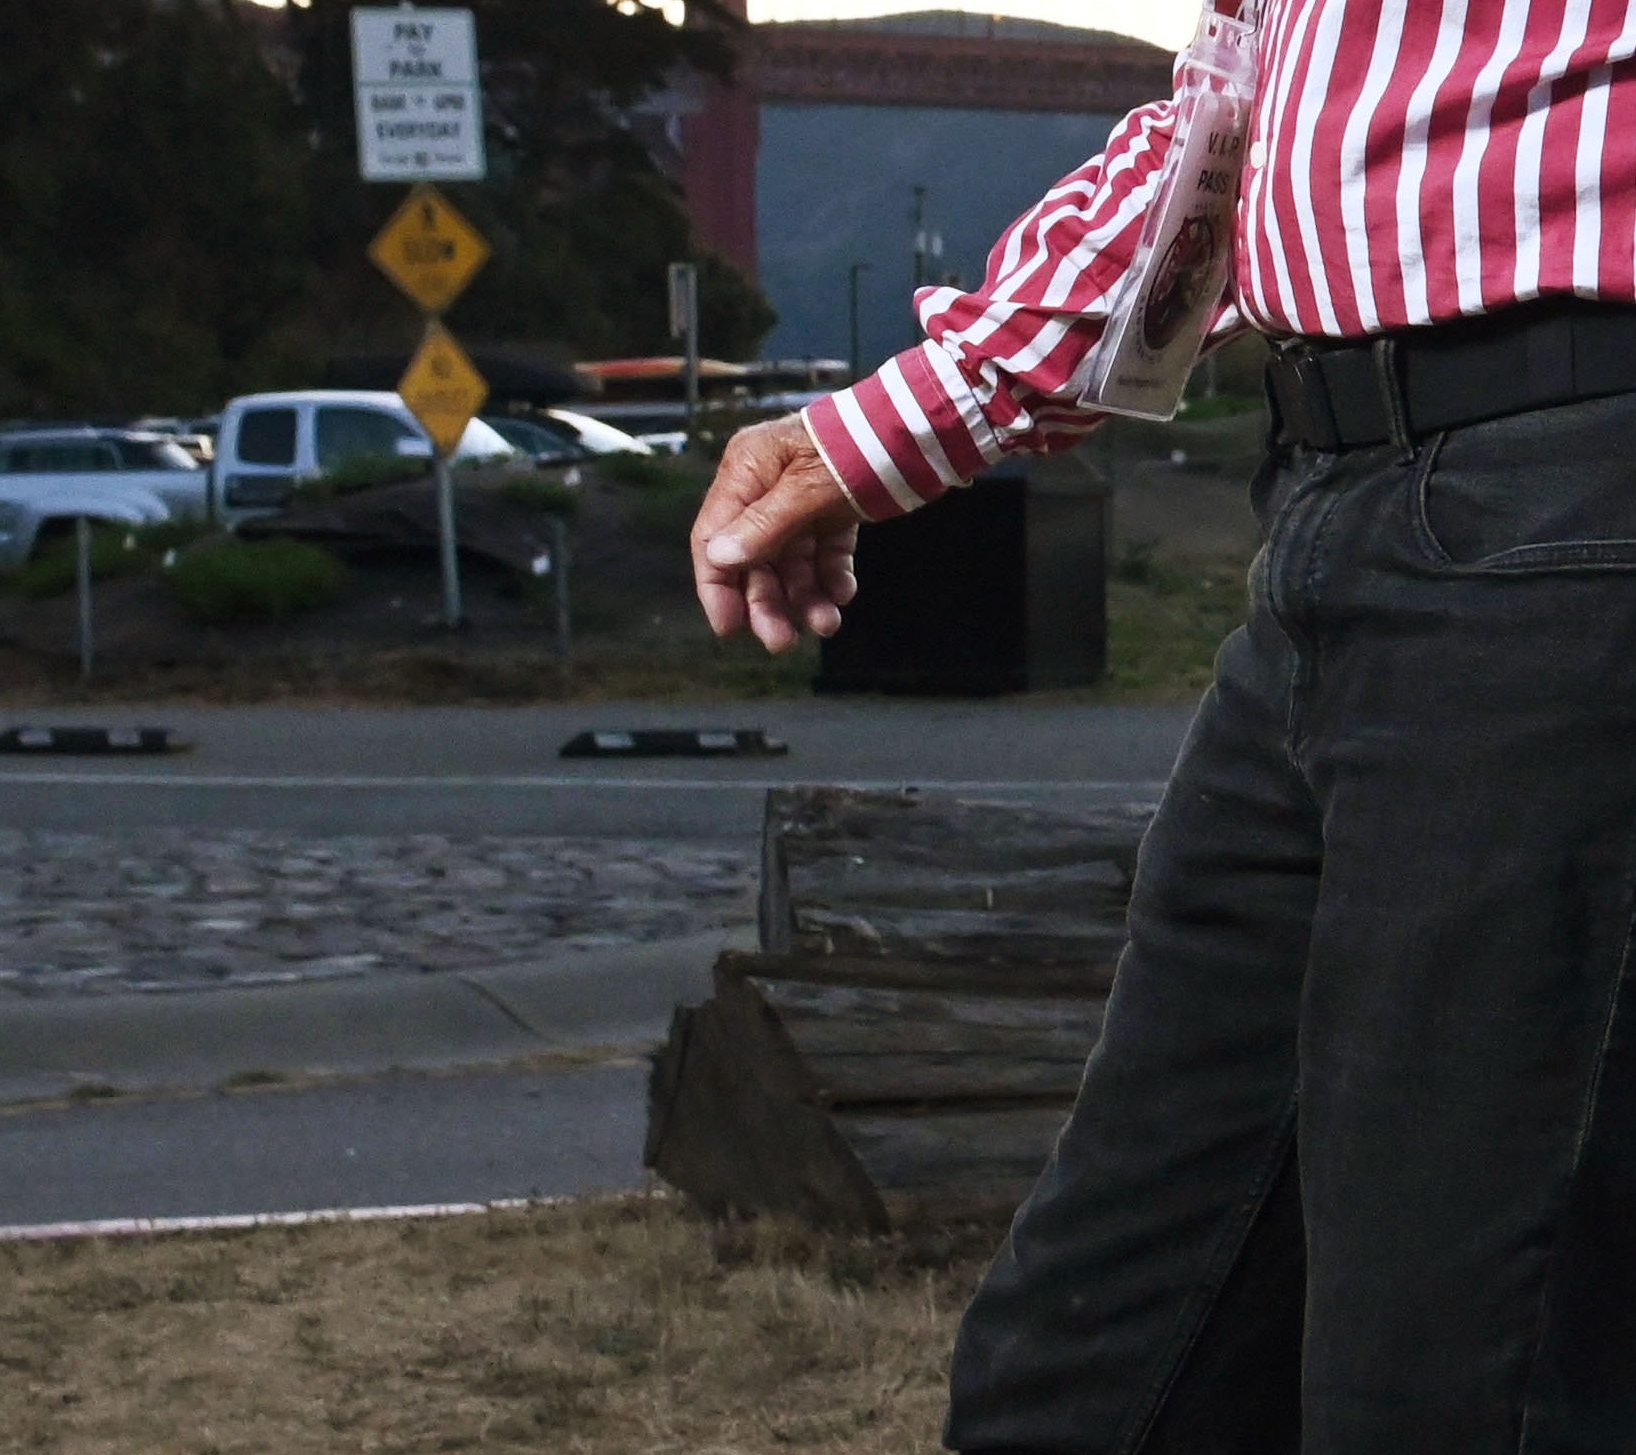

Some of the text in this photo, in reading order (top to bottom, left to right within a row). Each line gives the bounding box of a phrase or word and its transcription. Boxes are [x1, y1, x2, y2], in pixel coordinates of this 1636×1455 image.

[394, 24, 433, 41] PAY
[389, 60, 443, 77] PARK
[1197, 170, 1231, 194] PASS
